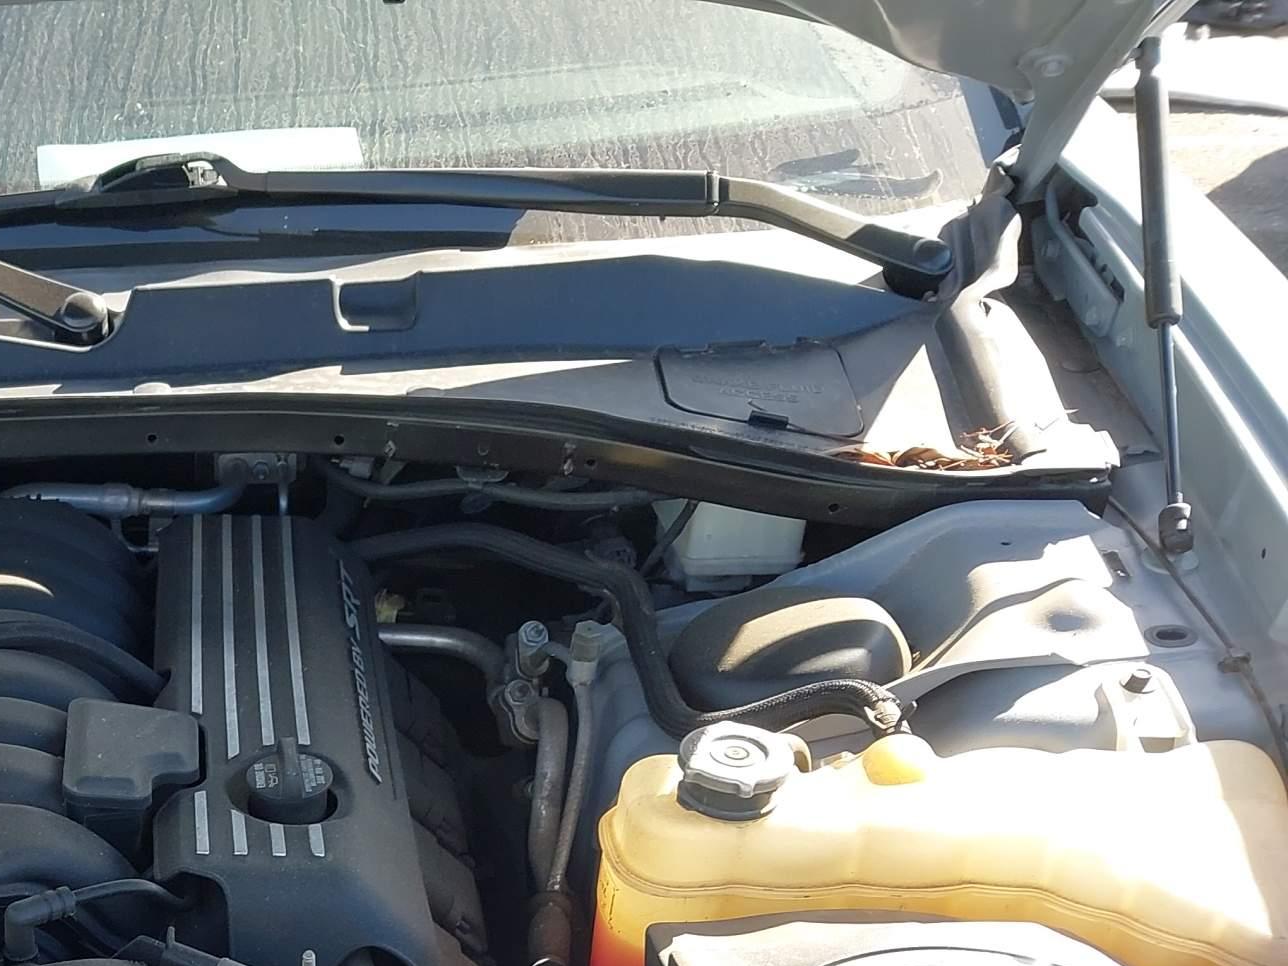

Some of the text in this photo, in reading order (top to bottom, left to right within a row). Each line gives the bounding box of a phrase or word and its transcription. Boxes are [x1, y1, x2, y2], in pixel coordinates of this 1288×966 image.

[339, 560, 383, 783] POWERED BY SRT
